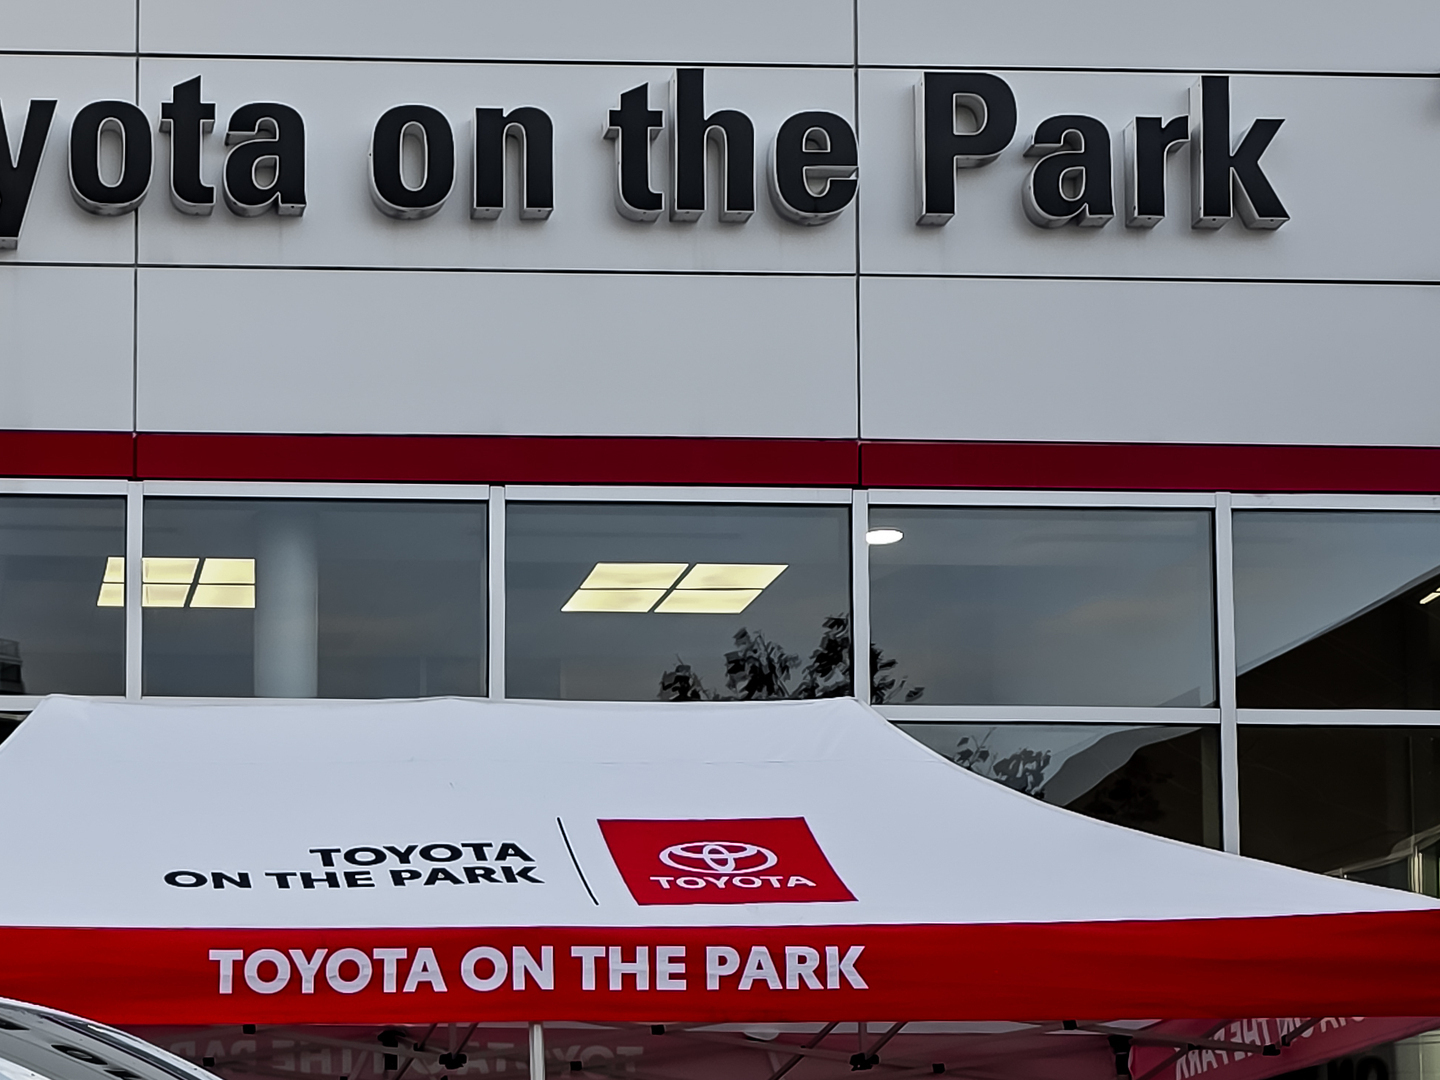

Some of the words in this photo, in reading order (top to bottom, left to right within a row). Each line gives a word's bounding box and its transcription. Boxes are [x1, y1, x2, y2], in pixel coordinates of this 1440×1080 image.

[369, 103, 554, 222] on
[602, 68, 860, 227] the
[913, 71, 1291, 231] Park
[309, 842, 535, 867] TOYOTA
[163, 869, 251, 890] ON
[265, 869, 378, 890] THE
[390, 865, 545, 888] PARK
[650, 873, 816, 890] TOYOTA
[209, 947, 448, 995] TOYOTA
[460, 945, 555, 992] ON
[571, 945, 687, 992] THE
[705, 943, 869, 991] PARK
